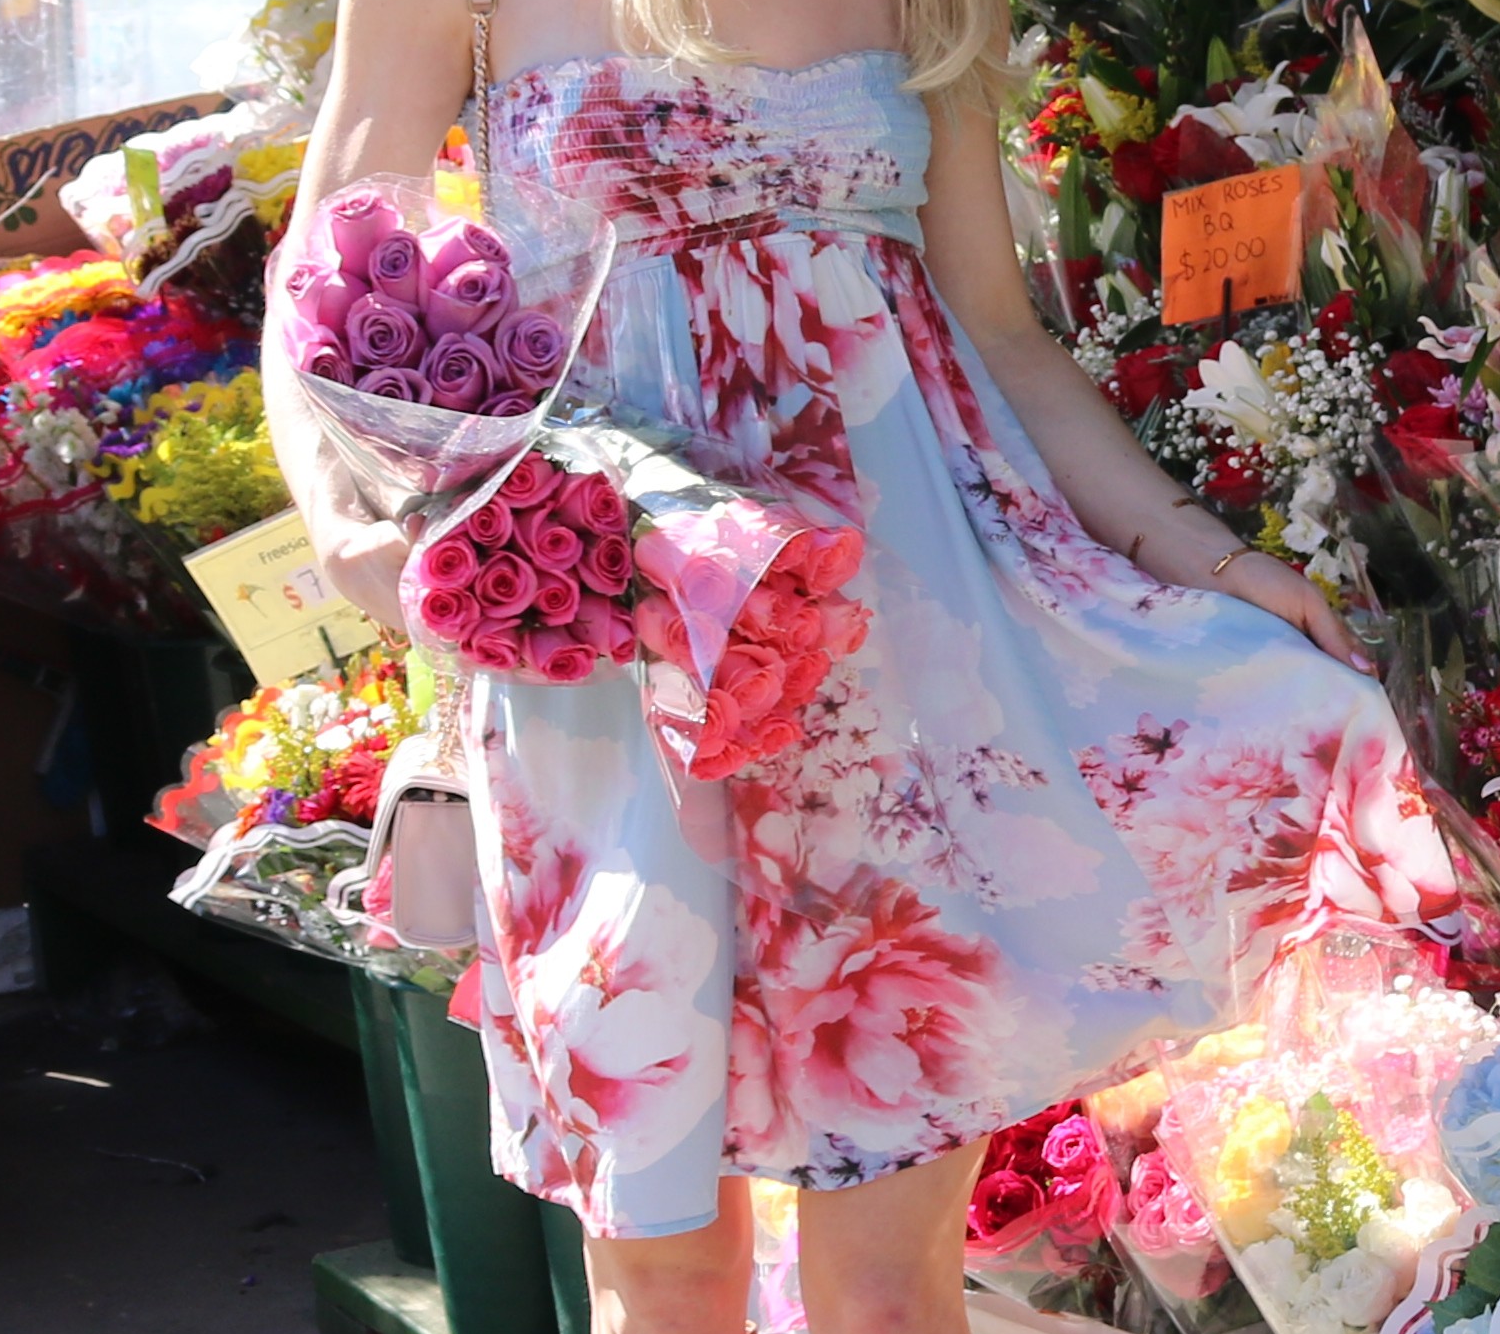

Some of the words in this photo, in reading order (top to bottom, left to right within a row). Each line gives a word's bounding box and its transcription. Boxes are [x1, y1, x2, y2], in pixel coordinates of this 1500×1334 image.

[1172, 193, 1206, 218] MIX
[1222, 174, 1284, 204] ROSES
[258, 536, 310, 565] Freesia
